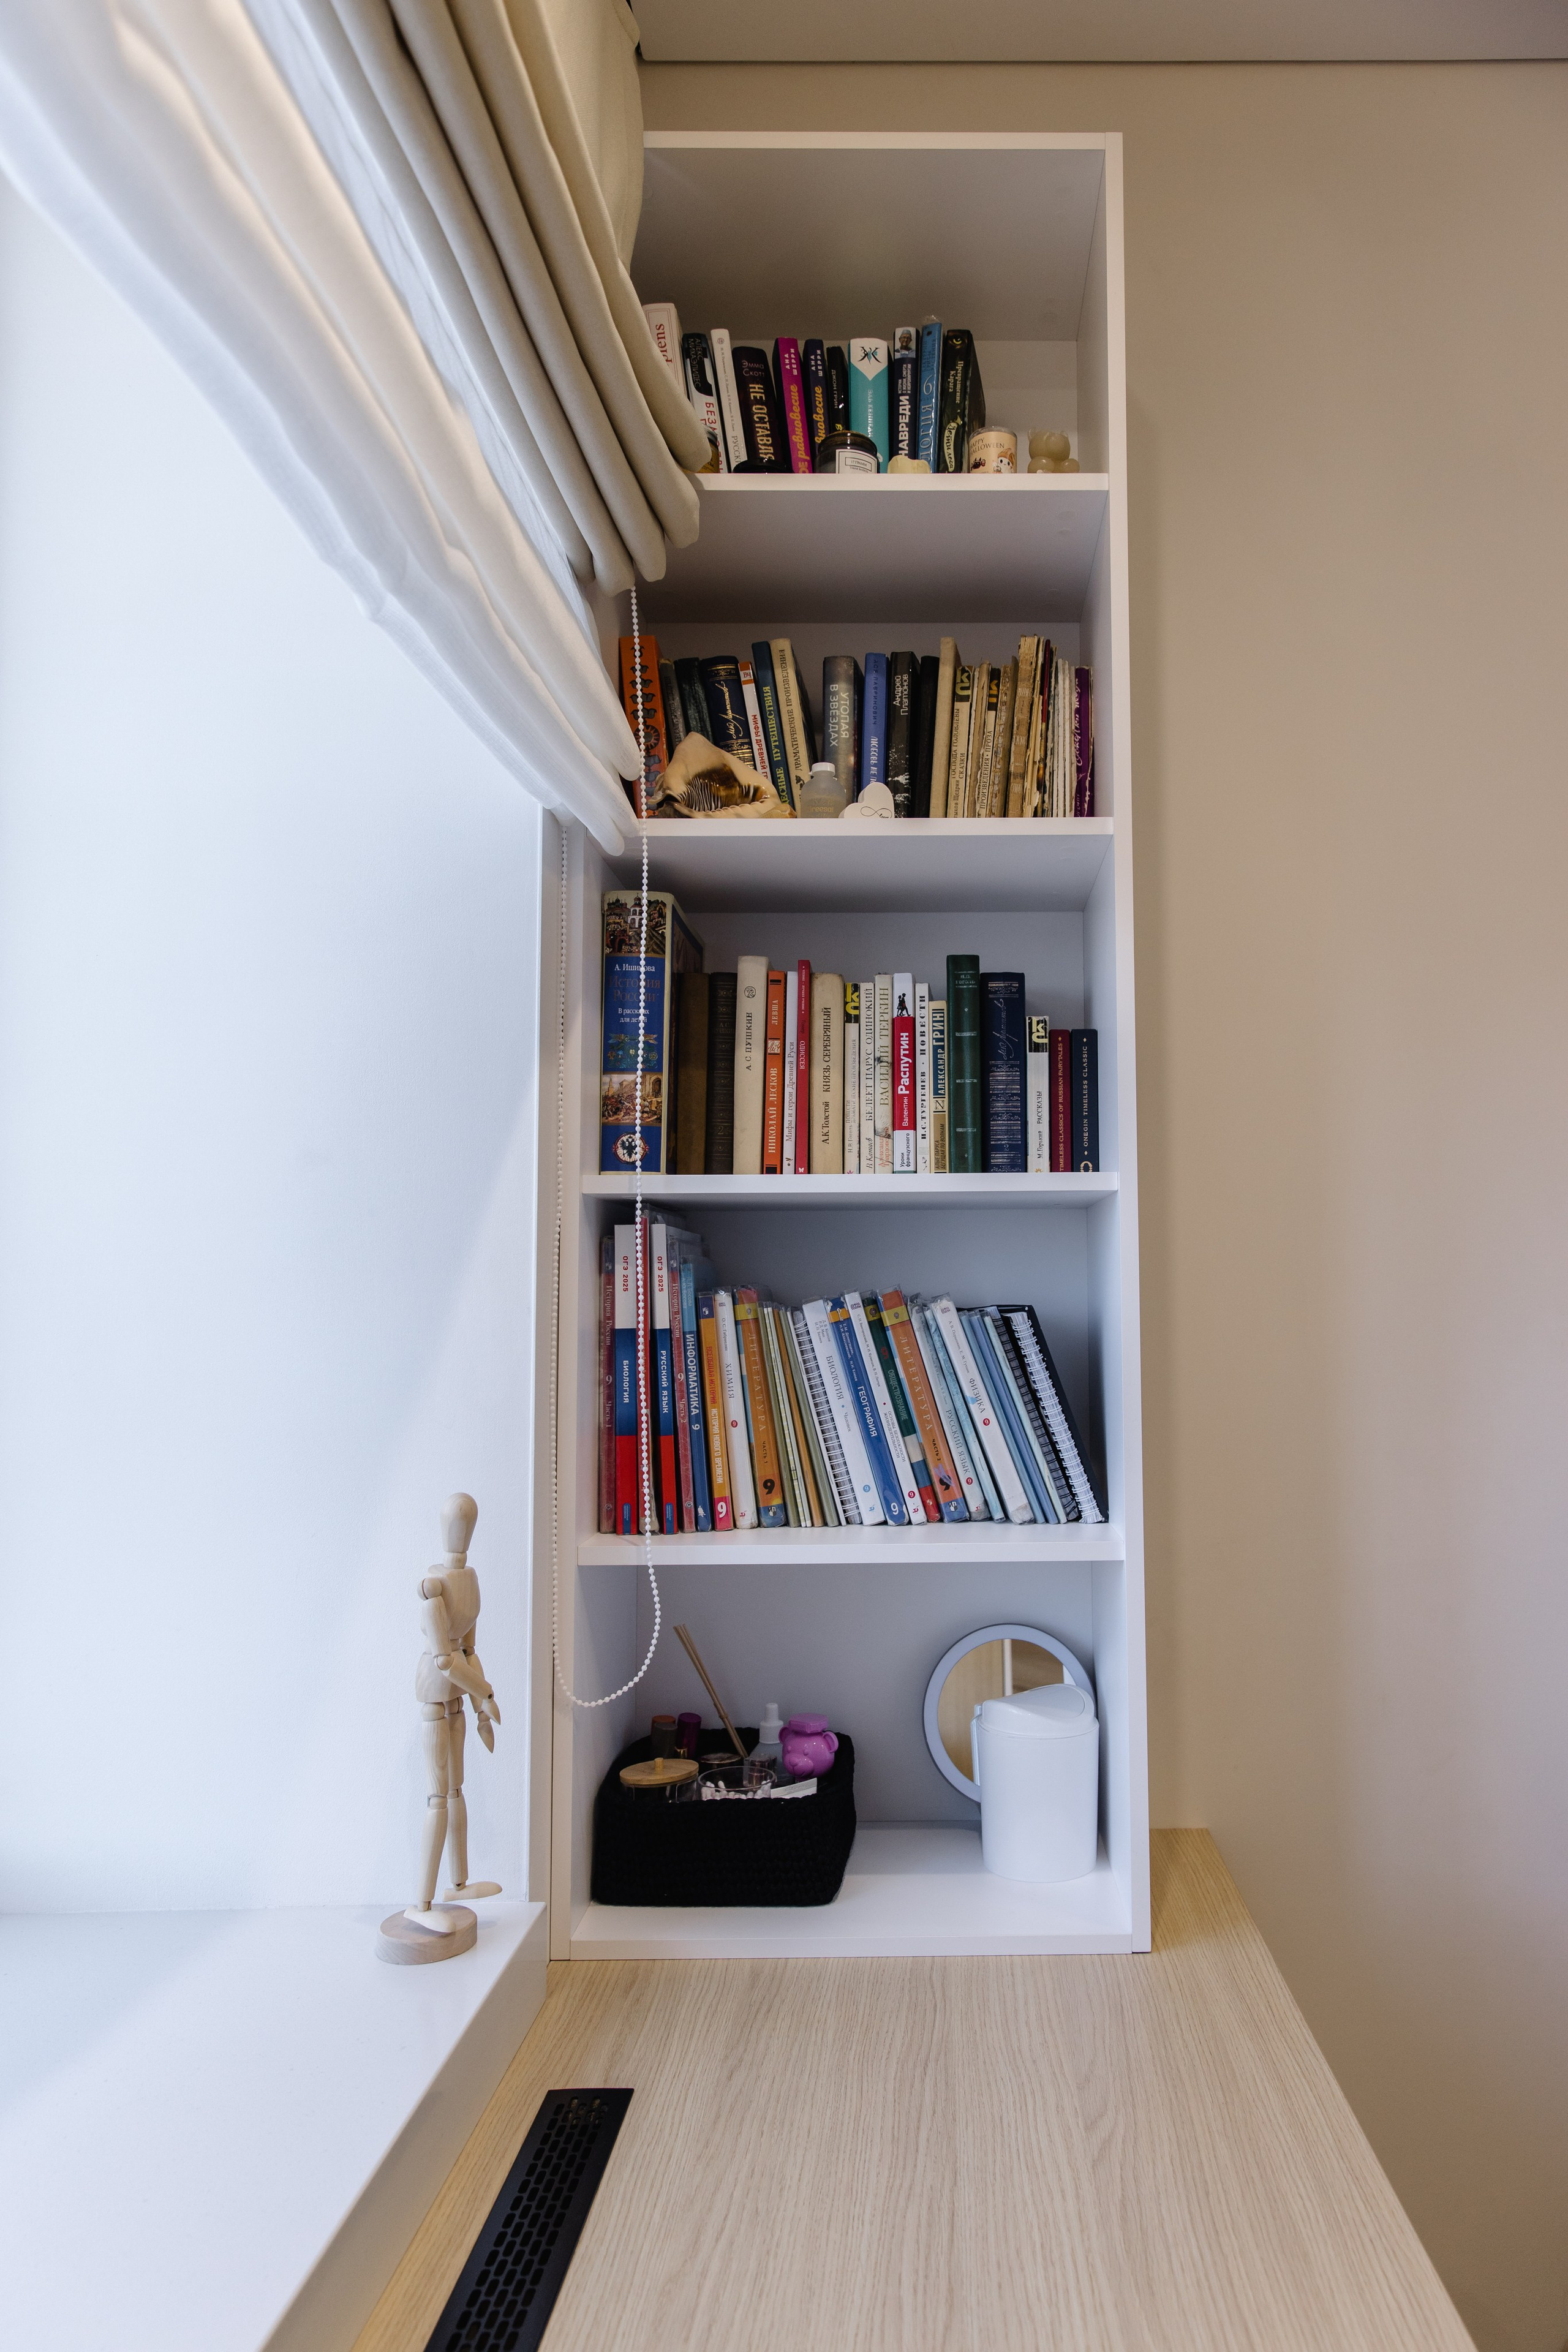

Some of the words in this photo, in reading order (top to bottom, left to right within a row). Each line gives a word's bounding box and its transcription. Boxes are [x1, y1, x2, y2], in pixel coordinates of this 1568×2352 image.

[655, 323, 673, 364] piens
[688, 338, 701, 388] МИХАЭЛИДЕС
[694, 338, 704, 361] АЛЕКС
[749, 383, 766, 401] НЕ
[956, 361, 965, 404] Превращение
[790, 383, 810, 460] равновесие
[919, 404, 932, 461] ЛОГИЯ
[778, 649, 793, 707] ПРОИЗВЕДЕНИЯ
[893, 675, 902, 706] Андрей
[752, 714, 761, 738] МИФЫ
[763, 686, 781, 761] ПУТЕШЕСТВИЯ
[829, 695, 840, 747] ЗВЁЗДАХ
[840, 692, 850, 739] УТОПАЯ
[755, 738, 766, 771] ДРЕВНЕЙ
[786, 709, 802, 771] ДРАМАТИЧЕСКИЕ
[870, 736, 878, 766] ЛЮБОВЬ
[870, 767, 878, 777] НЕ
[980, 758, 990, 809] ПРОИЗВЕДЕНИЯ
[880, 987, 889, 1039] ТЕРКИН
[933, 1011, 944, 1046] ГРИН
[823, 1007, 831, 1063] СЕРЕБРЯНЫЙ
[877, 1045, 889, 1107] ВАСИЛИЙ
[898, 1032, 913, 1095] Распутин
[1059, 1104, 1063, 1112] OF
[767, 1107, 777, 1153] НИКОЛАЙ
[606, 1375, 612, 1385] 9
[660, 1351, 669, 1387] РУССКИЙ
[677, 1373, 684, 1382] 9
[686, 1334, 699, 1415] ИНФОРМАТИКА
[706, 1346, 715, 1380] ВСЕОБЩАЯ
[725, 1363, 735, 1398] ХИМИЯ
[748, 1333, 766, 1431] ЛИТЕРАТУРА
[826, 1355, 845, 1401] БИОЛОГИЯ
[900, 1336, 933, 1431] ЛИТЕРАТУРА
[858, 1386, 877, 1438] ГЕОГРАФИЯ
[888, 1370, 908, 1421] ОБЩЕСТВОЗНАНИЕ
[970, 1378, 986, 1413] ФИЗИКА
[710, 1408, 720, 1433] ИСТОРИЯ
[946, 1409, 964, 1450] РУССКИЙ
[959, 1450, 971, 1475] ЯЗЫК
[894, 1429, 906, 1463] БЕЗОПАСНОСТИ
[763, 1479, 775, 1495] 9
[891, 1502, 899, 1515] 9
[718, 1502, 727, 1518] 9
